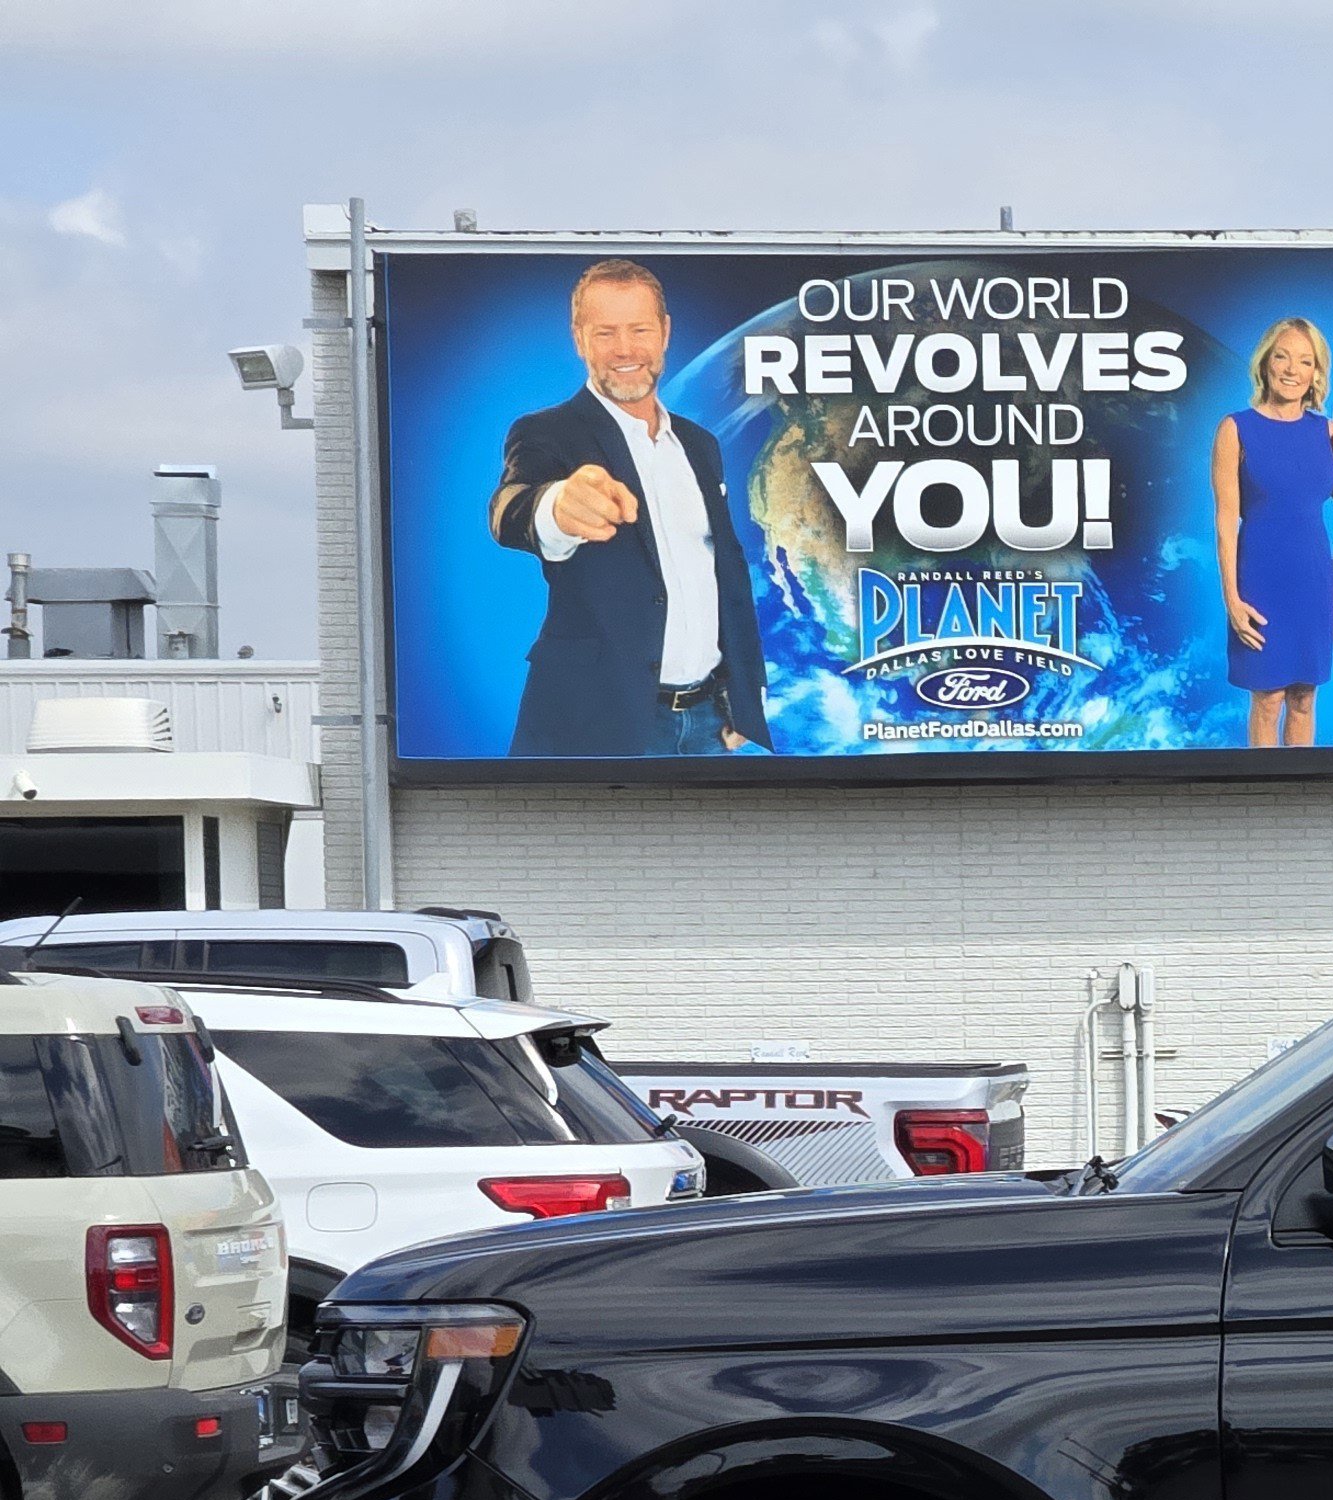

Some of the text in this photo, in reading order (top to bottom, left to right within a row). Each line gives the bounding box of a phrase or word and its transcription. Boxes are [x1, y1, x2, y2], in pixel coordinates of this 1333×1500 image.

[798, 276, 1128, 322] OUR WORLD
[743, 330, 1188, 395] REVOLVES
[848, 403, 1085, 448] AROUND
[810, 457, 1114, 553] YOU!
[898, 569, 1044, 582] RANDALL REED'S
[857, 567, 1083, 664] PLANET
[865, 648, 1073, 681] DALLAS LOVE FIELD
[937, 671, 1009, 704] Ford
[863, 719, 1083, 741] PlanetFordDallas.com
[649, 1089, 872, 1120] RAPTOR
